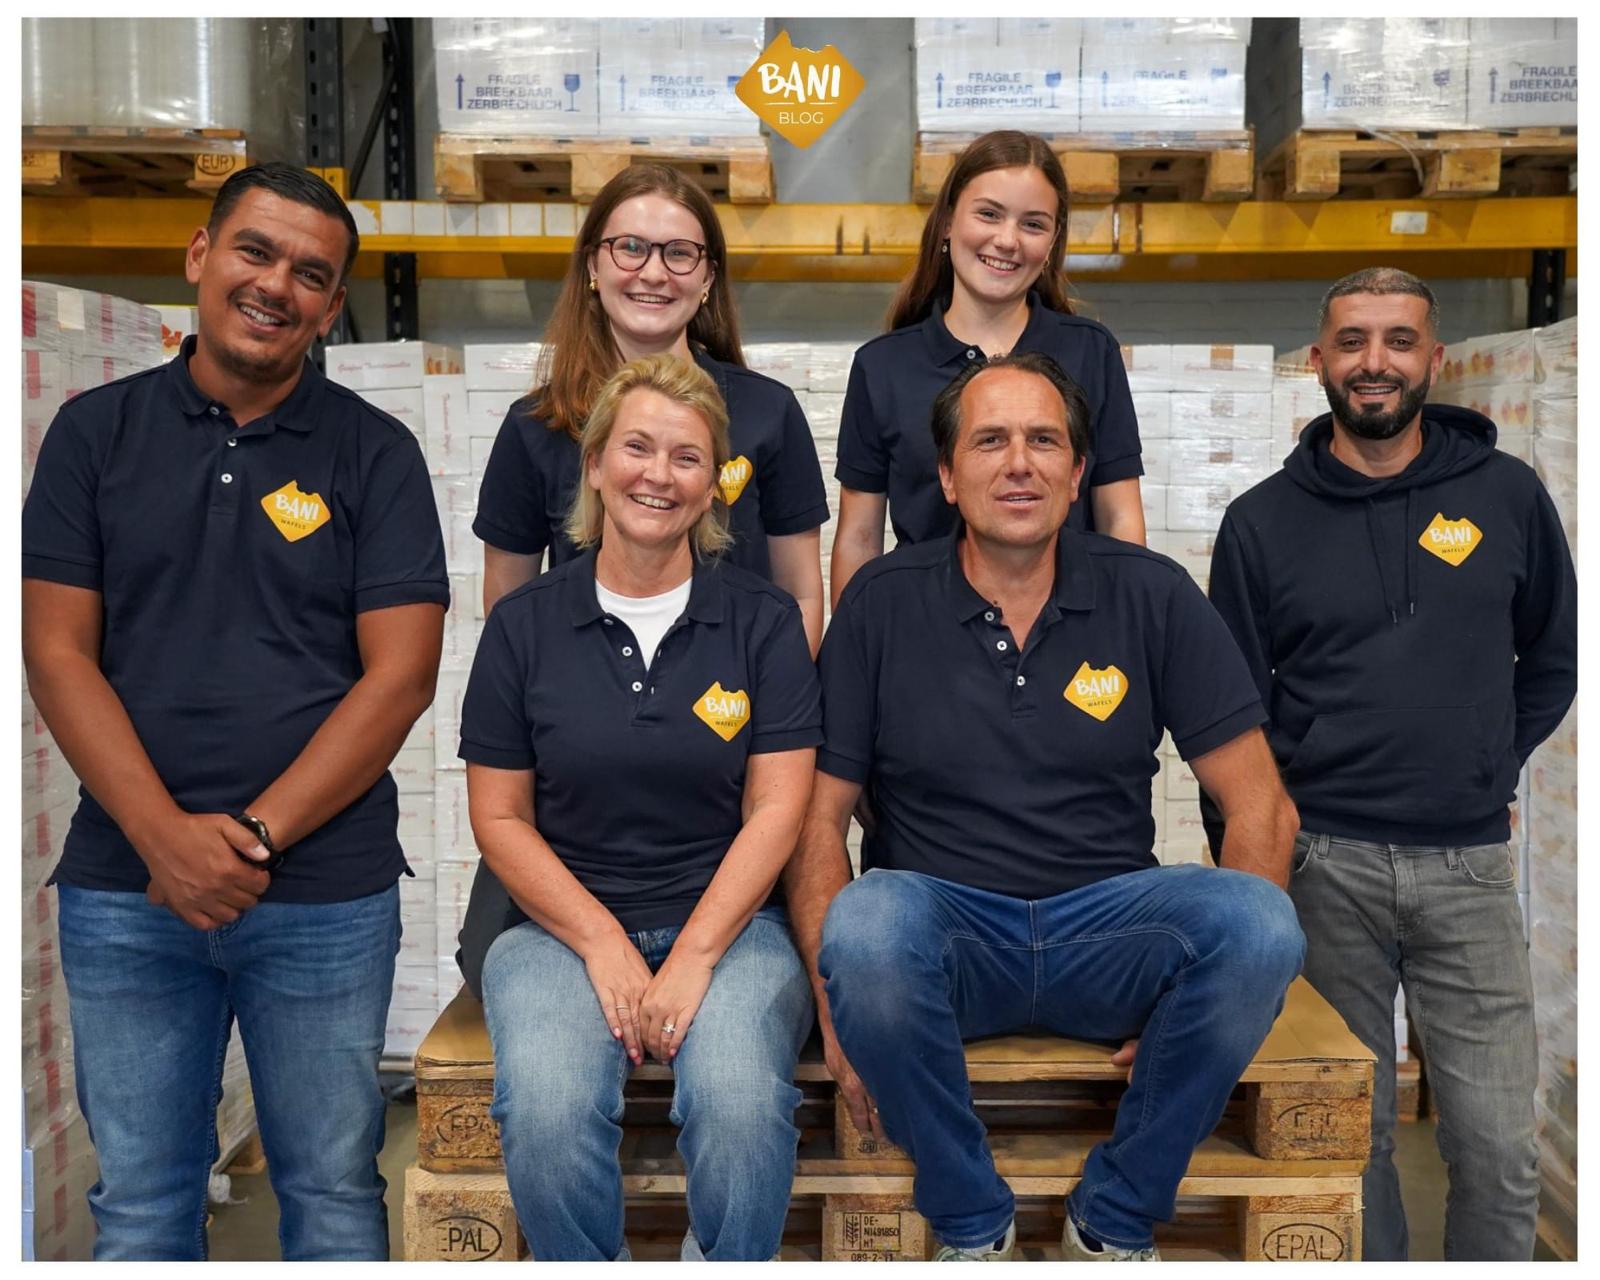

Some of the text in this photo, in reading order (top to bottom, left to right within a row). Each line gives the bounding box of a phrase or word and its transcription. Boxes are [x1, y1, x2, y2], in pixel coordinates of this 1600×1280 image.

[487, 74, 542, 85] FRAGILE
[968, 72, 1022, 83] FRAGILE
[1522, 66, 1577, 78] FRAGILE
[651, 75, 705, 87] FRAGILE
[476, 86, 553, 98] BREEKBAAR
[466, 99, 562, 111] ZERBRECHLICH
[202, 153, 230, 170] EUR
[719, 463, 747, 485] ANI
[275, 494, 320, 521] BANI
[1430, 526, 1472, 547] BANI
[1074, 674, 1120, 698] BANI
[704, 696, 747, 718] BANI
[1276, 1233, 1332, 1260] EPAL
